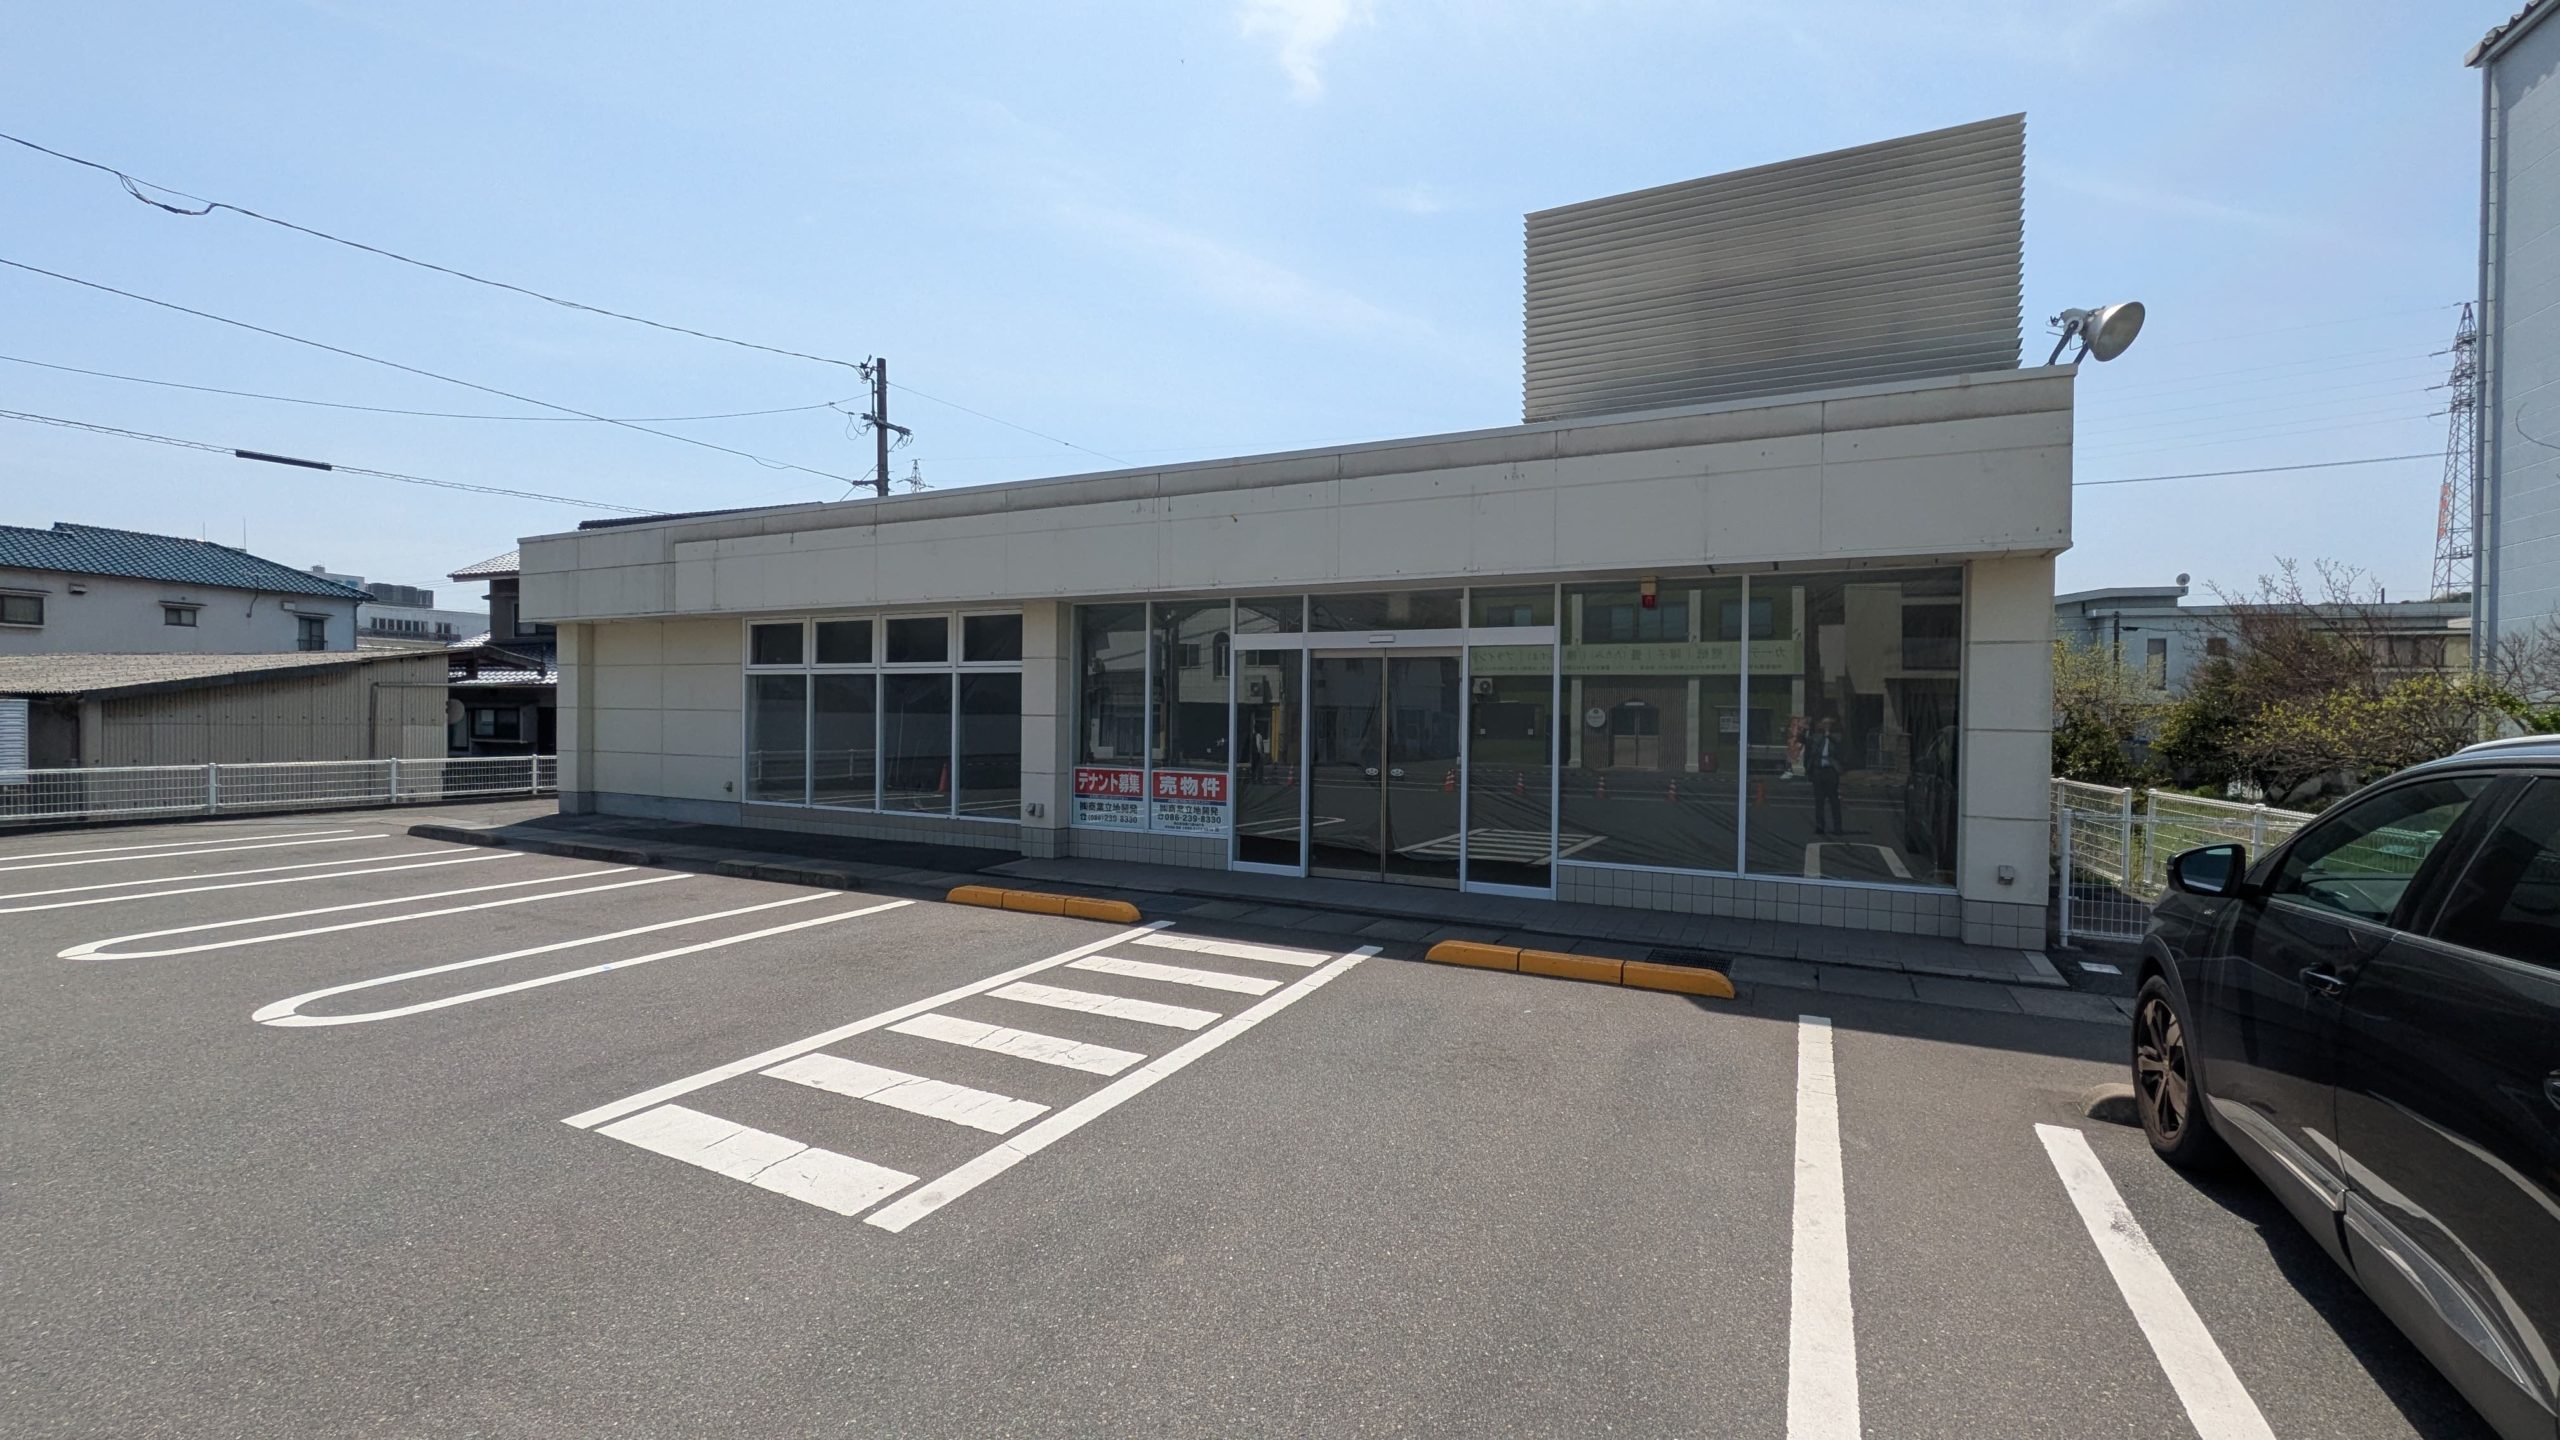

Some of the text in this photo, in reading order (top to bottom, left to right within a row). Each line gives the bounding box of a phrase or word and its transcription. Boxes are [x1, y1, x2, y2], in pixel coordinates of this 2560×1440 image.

[1078, 772, 1140, 793] テナント募集
[1159, 775, 1220, 798] 売物件
